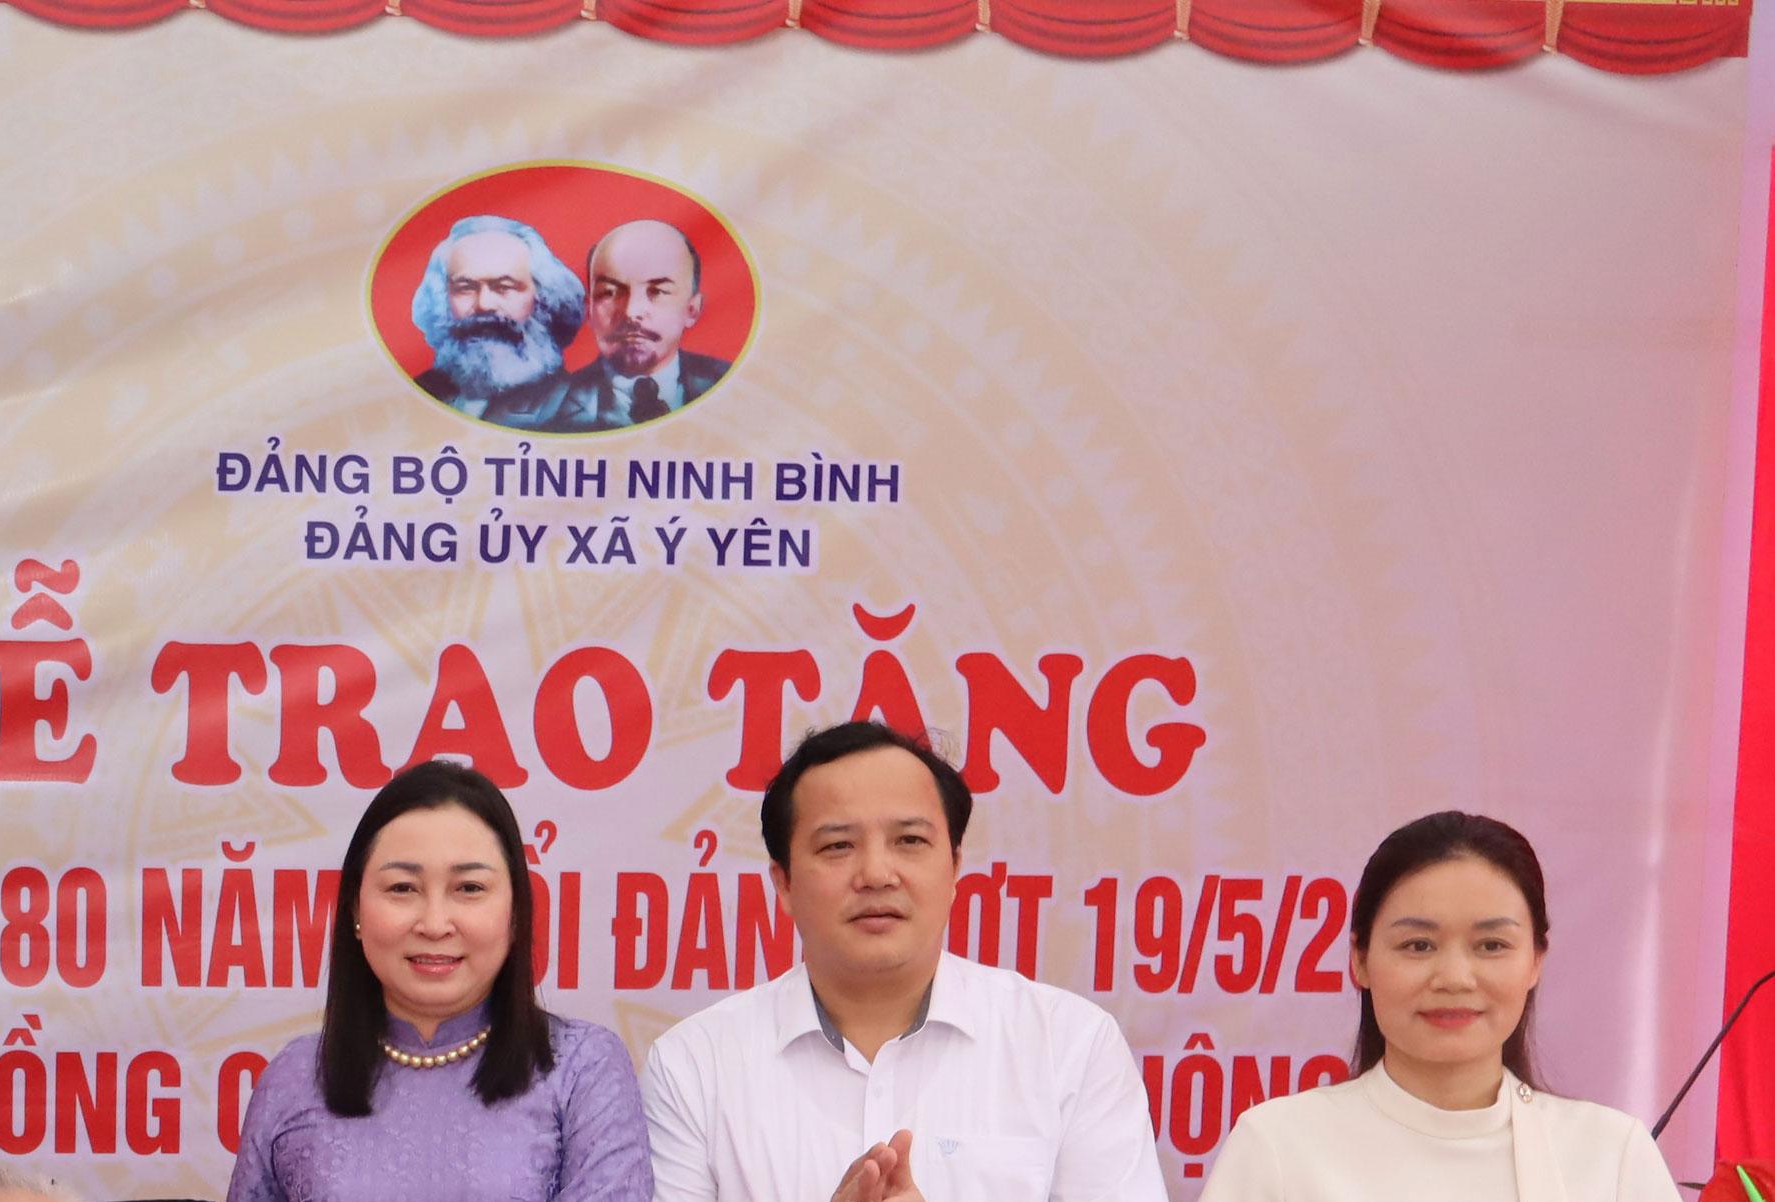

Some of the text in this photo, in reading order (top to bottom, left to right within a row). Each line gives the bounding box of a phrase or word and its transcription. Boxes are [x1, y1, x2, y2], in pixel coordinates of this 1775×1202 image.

[216, 436, 900, 504] ĐẢNG BỘ TỈNH NINH BÌNH
[304, 505, 811, 567] ĐẢNG ỦY XÃ Ý YÊN
[151, 641, 654, 791] TRAO
[0, 866, 107, 988] 80
[141, 841, 343, 988] NĂM
[611, 829, 802, 991] ĐẢN
[1084, 874, 1362, 995] 19/5/2
